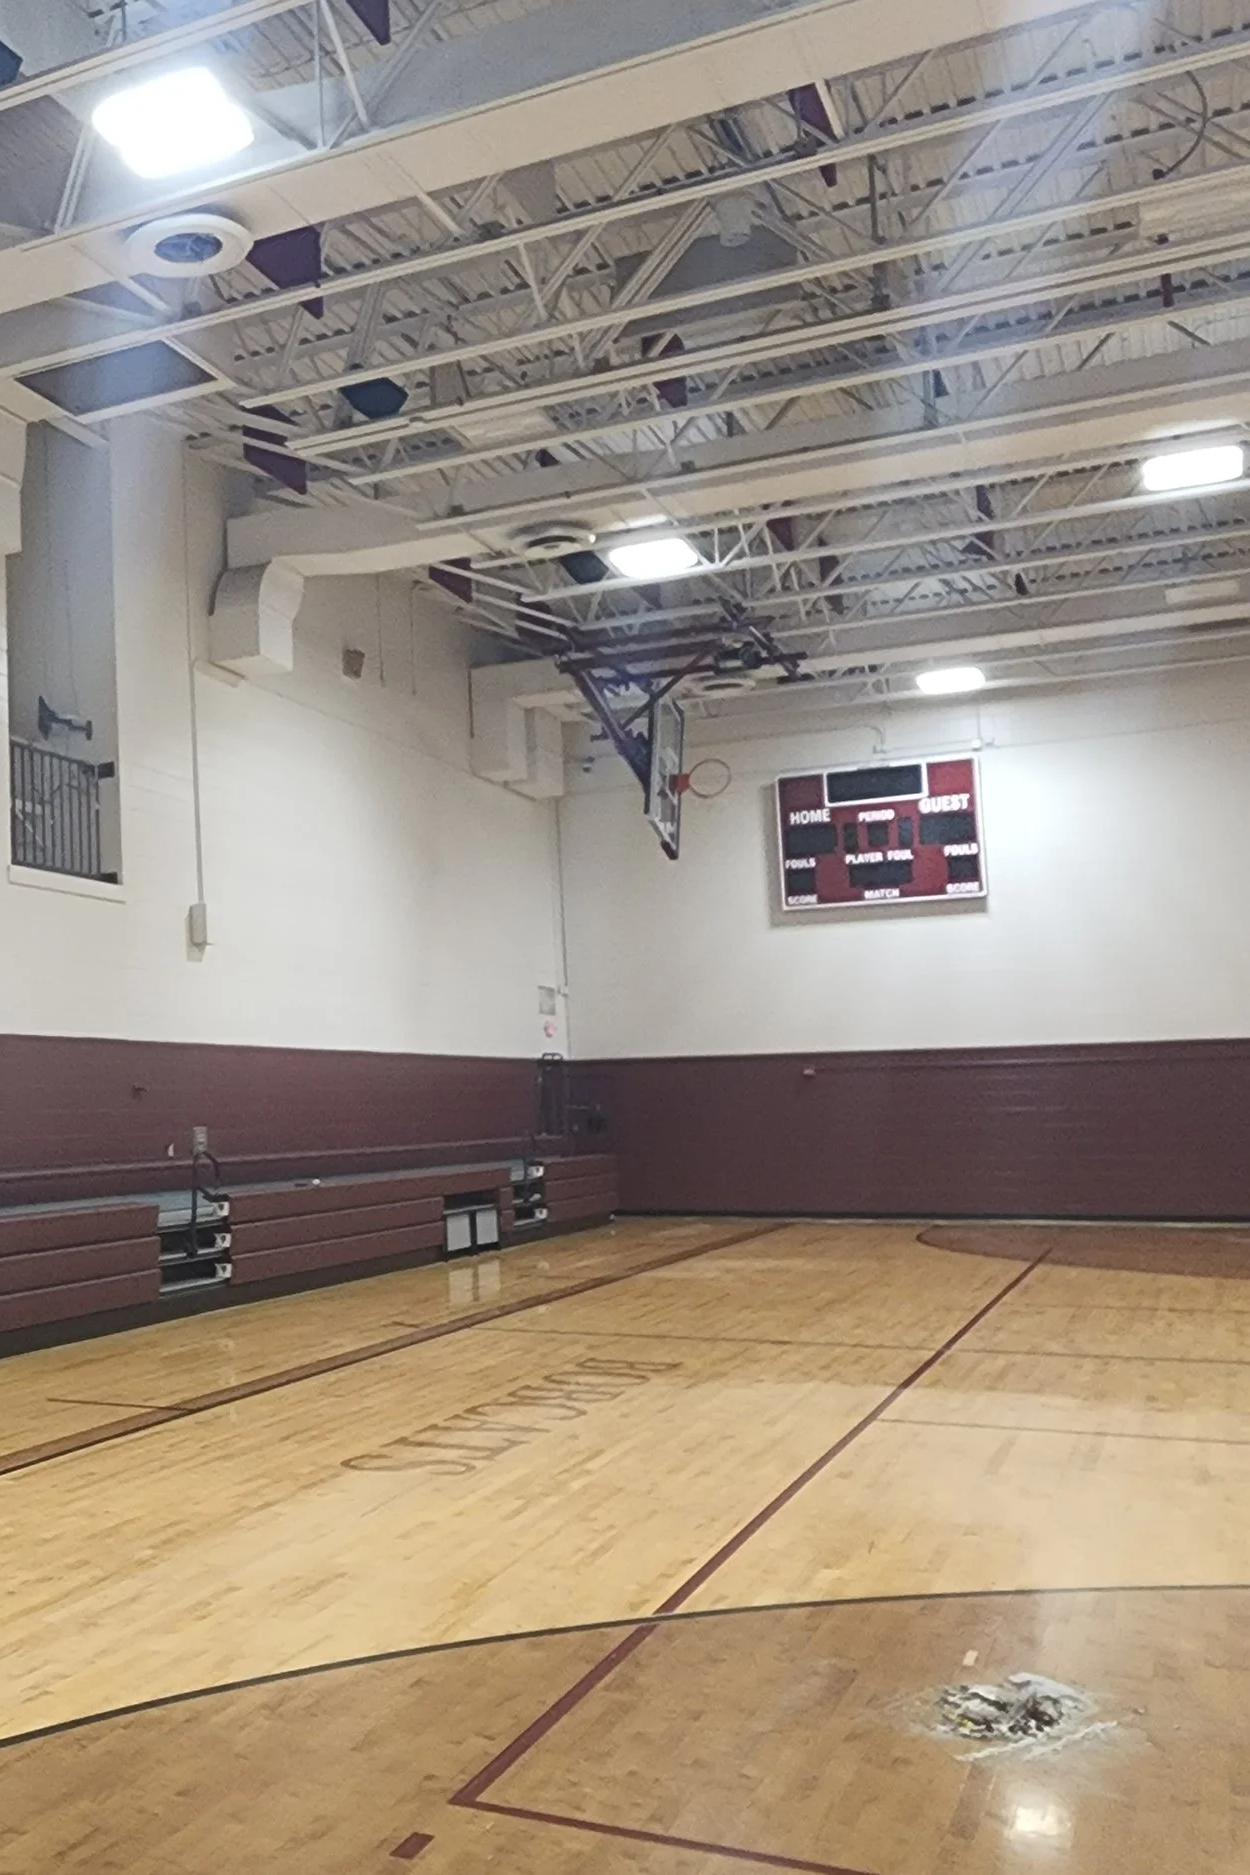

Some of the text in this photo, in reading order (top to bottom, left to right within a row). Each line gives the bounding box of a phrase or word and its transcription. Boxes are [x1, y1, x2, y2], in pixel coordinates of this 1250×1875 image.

[918, 793, 970, 814] GUEST
[789, 808, 831, 825] HOME
[340, 1357, 684, 1476] BOBCATS
